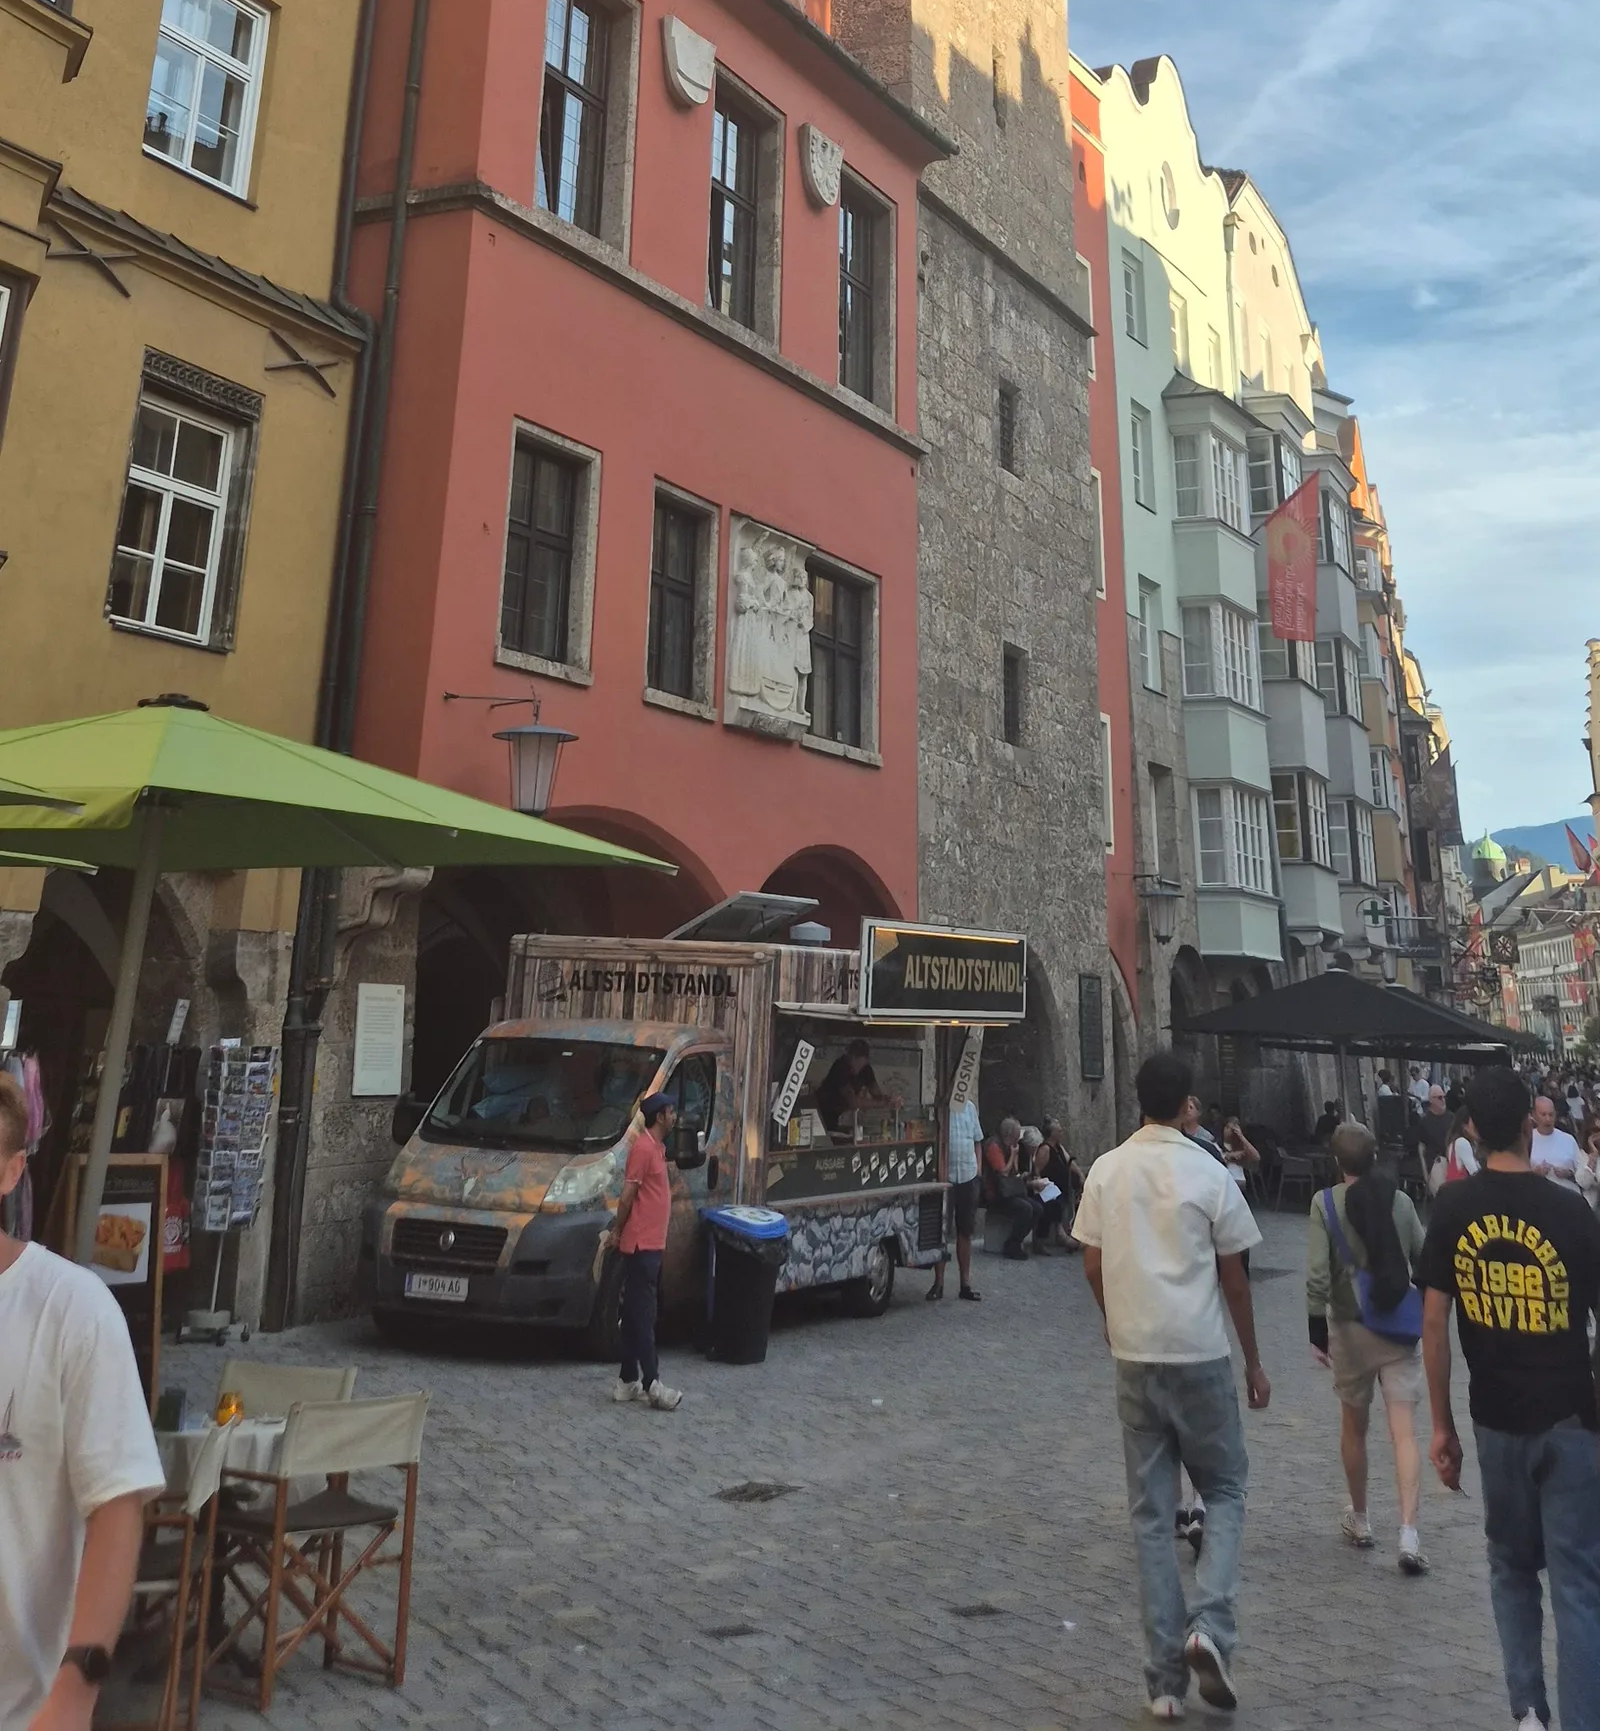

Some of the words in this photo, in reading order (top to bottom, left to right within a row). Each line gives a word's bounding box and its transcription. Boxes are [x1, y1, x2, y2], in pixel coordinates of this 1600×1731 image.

[569, 970, 737, 997] ALTSTADTSTANDL
[904, 954, 1023, 994] ALTSTADTSTANDL
[776, 1046, 810, 1121] HOTDOG
[953, 1049, 977, 1104] BOSNA
[1454, 1214, 1569, 1299] ESTABLISHED
[1478, 1259, 1544, 1300] 1992
[1460, 1291, 1569, 1333] REVIEW
